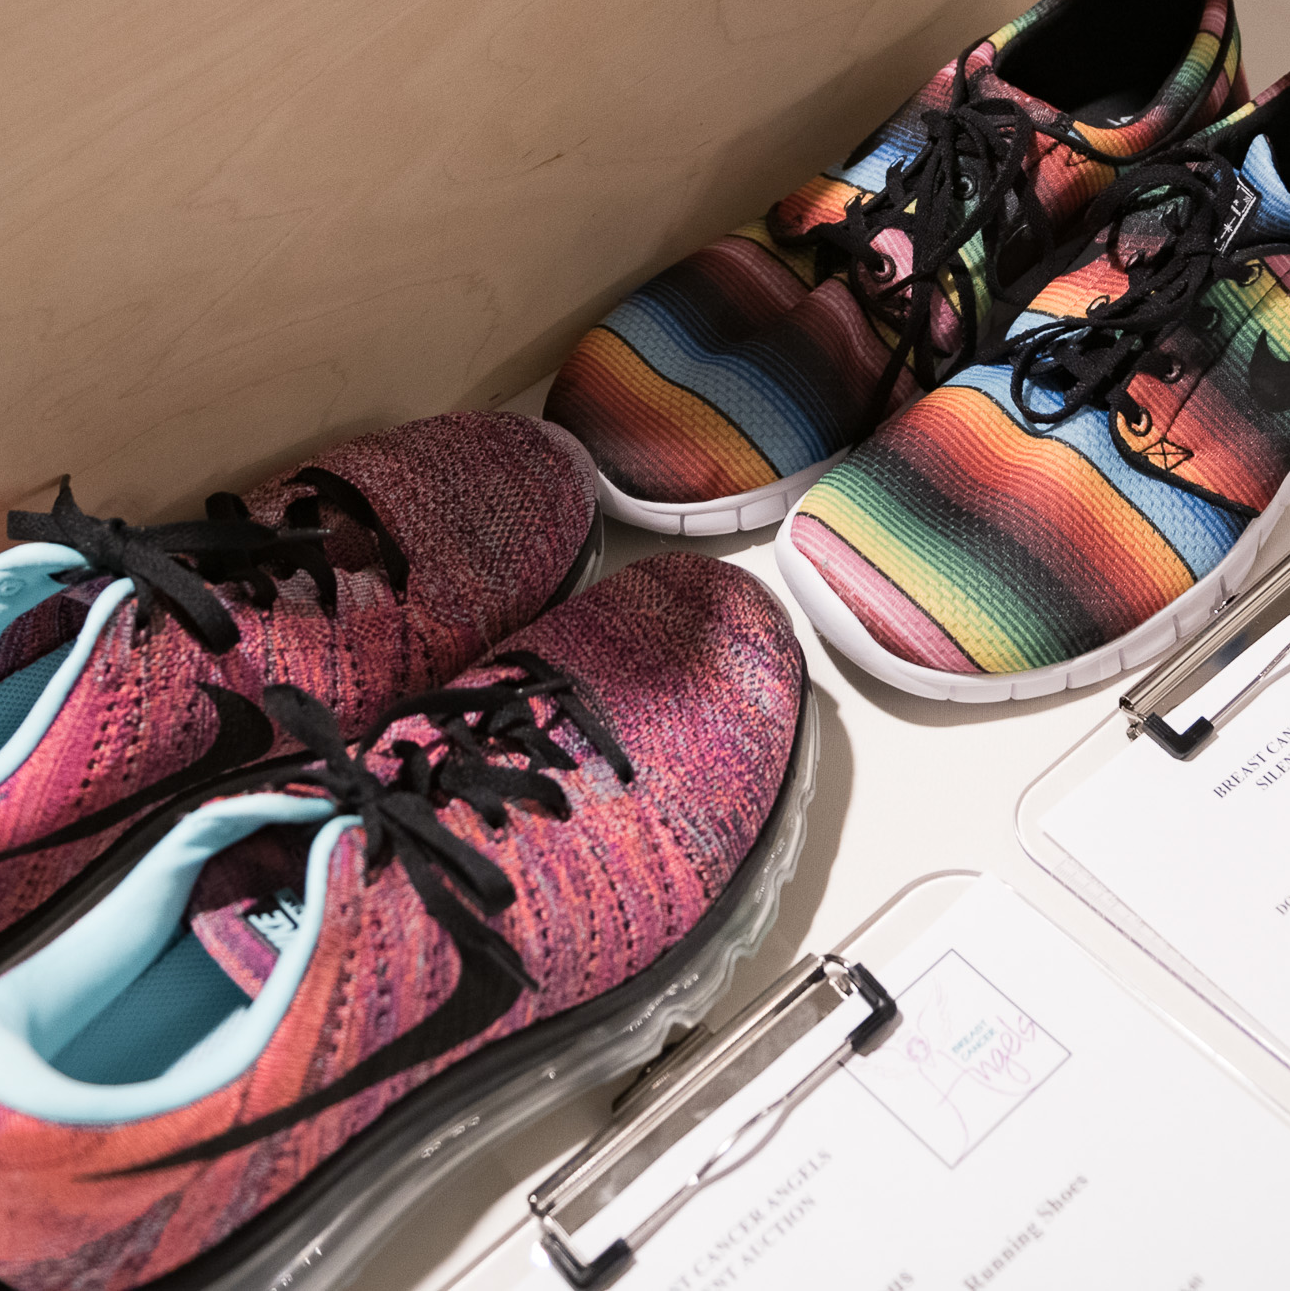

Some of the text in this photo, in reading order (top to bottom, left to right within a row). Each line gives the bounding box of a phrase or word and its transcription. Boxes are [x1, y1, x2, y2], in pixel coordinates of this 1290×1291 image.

[1213, 753, 1266, 798] BREAST
[693, 1150, 832, 1277] CANCER ANGELS
[741, 1196, 816, 1267] AUCTION
[963, 1171, 1089, 1291] Running Shoes
